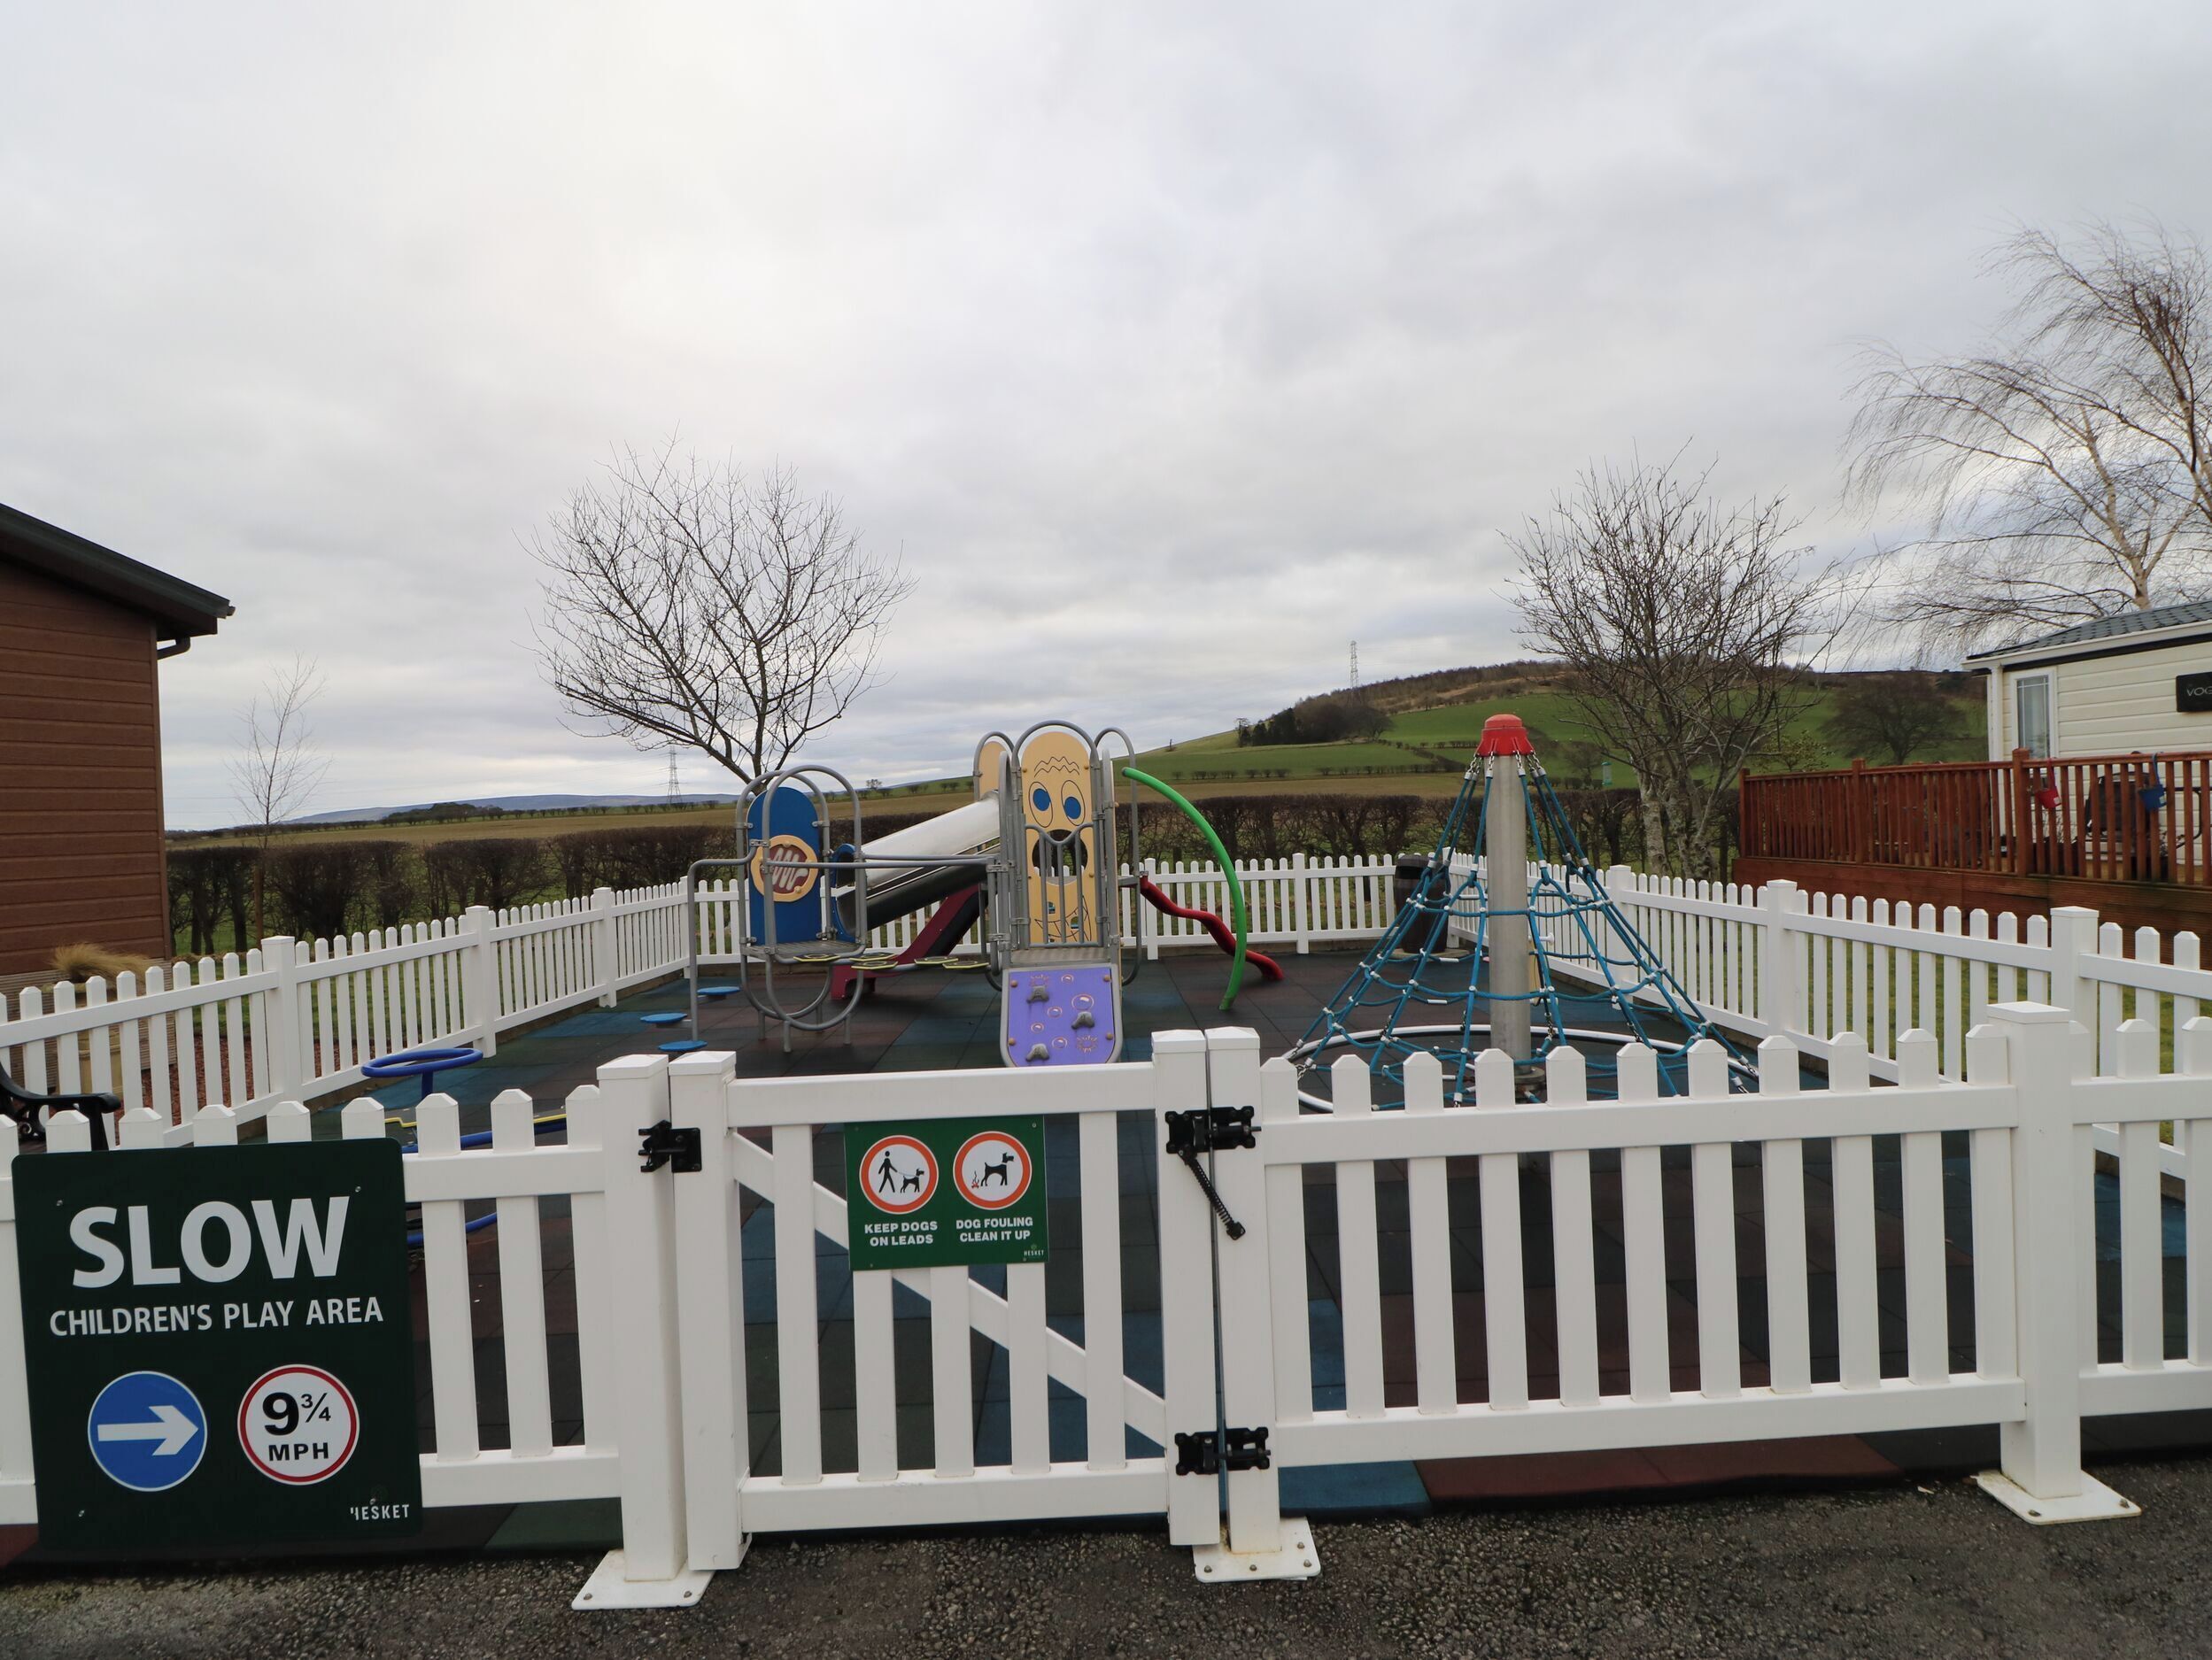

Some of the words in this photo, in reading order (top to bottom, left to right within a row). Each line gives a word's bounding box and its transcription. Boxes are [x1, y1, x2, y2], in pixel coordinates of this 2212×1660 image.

[864, 1223, 899, 1234] KEEP
[901, 1221, 938, 1232] DOGS
[955, 1219, 981, 1230] DOG
[984, 1216, 1033, 1228] FOULING
[69, 1195, 350, 1288] SLOW
[870, 1236, 889, 1247] ON
[891, 1234, 933, 1246] LEADS
[959, 1231, 999, 1243] CLEAN
[1001, 1231, 1011, 1241] IT
[1014, 1230, 1031, 1240] UP
[50, 1304, 213, 1337] CHILDREN'S
[224, 1301, 294, 1328] PLAY
[306, 1297, 383, 1325] AREA
[267, 1441, 329, 1462] MPH
